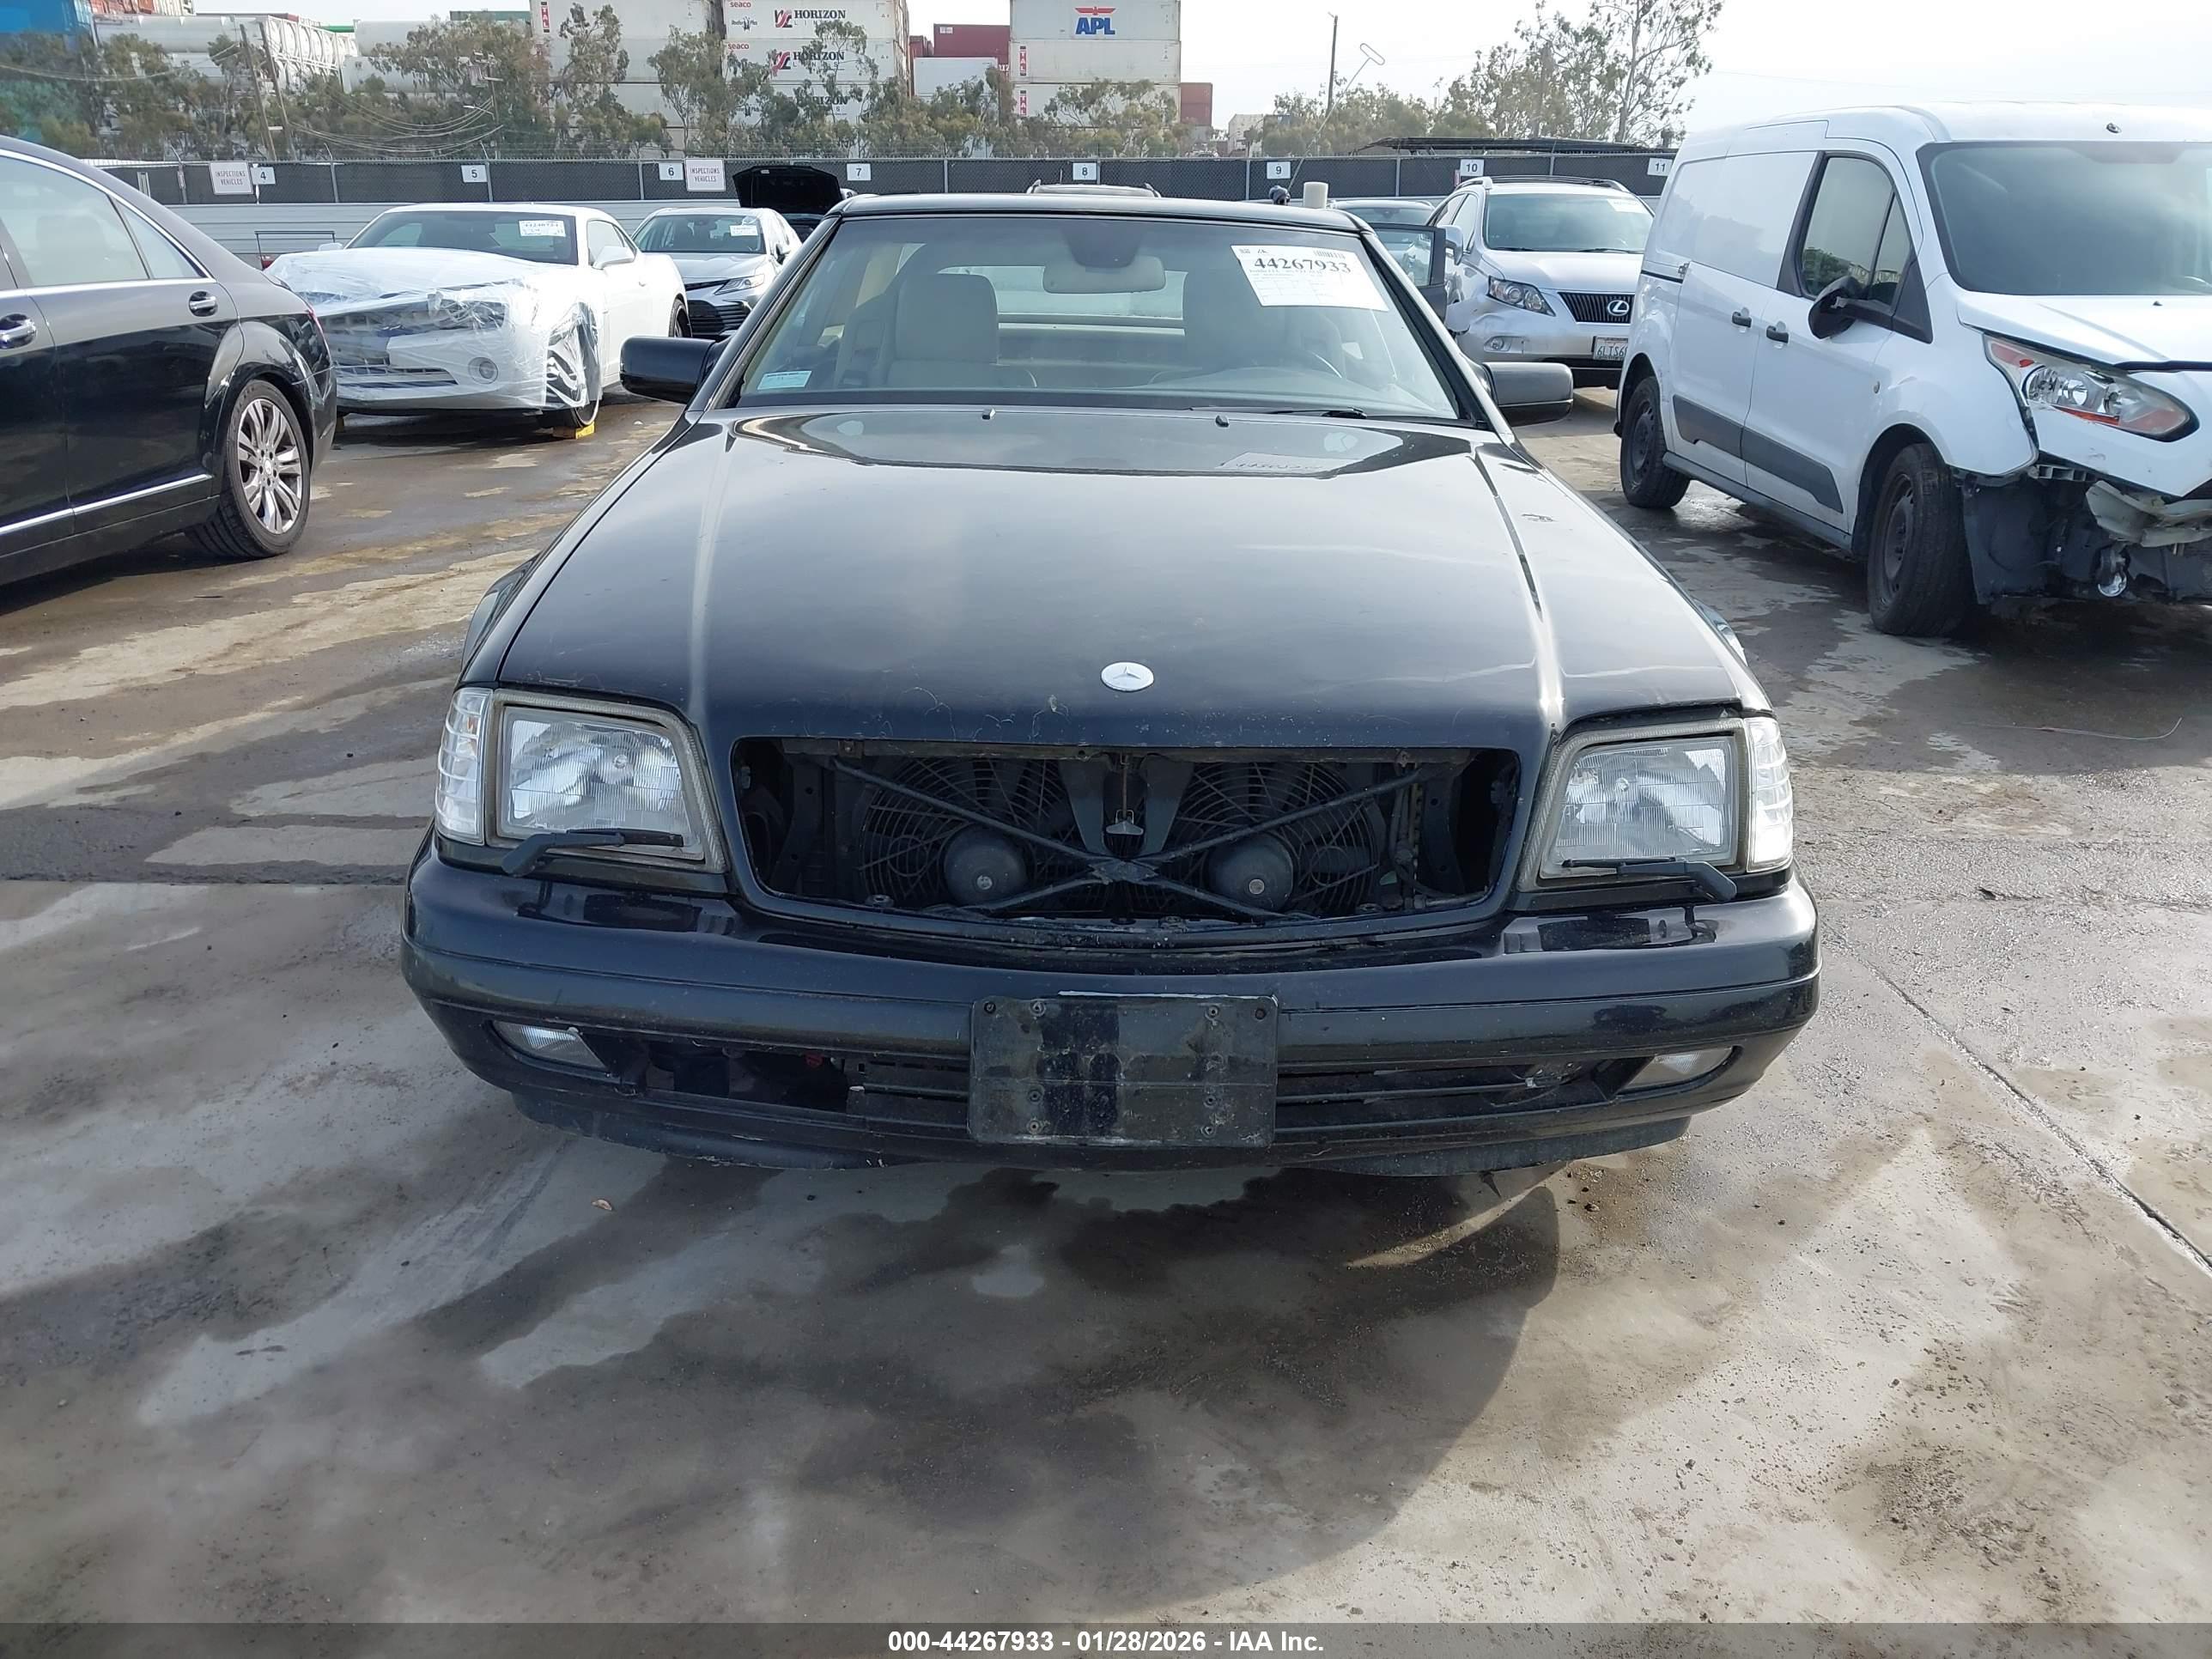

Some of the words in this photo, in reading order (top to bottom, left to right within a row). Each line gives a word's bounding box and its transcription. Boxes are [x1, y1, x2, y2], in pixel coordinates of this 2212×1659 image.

[793, 9, 846, 19] HORIZON
[1075, 17, 1115, 35] APL
[667, 167, 675, 176] 6
[855, 167, 862, 177] 7
[1082, 167, 1088, 176] 8
[1275, 166, 1282, 175] 9
[1466, 163, 1478, 173] 10
[1655, 162, 1666, 173] 11
[260, 172, 266, 180] 4
[471, 168, 477, 179] 5
[1254, 257, 1352, 273] 44267933
